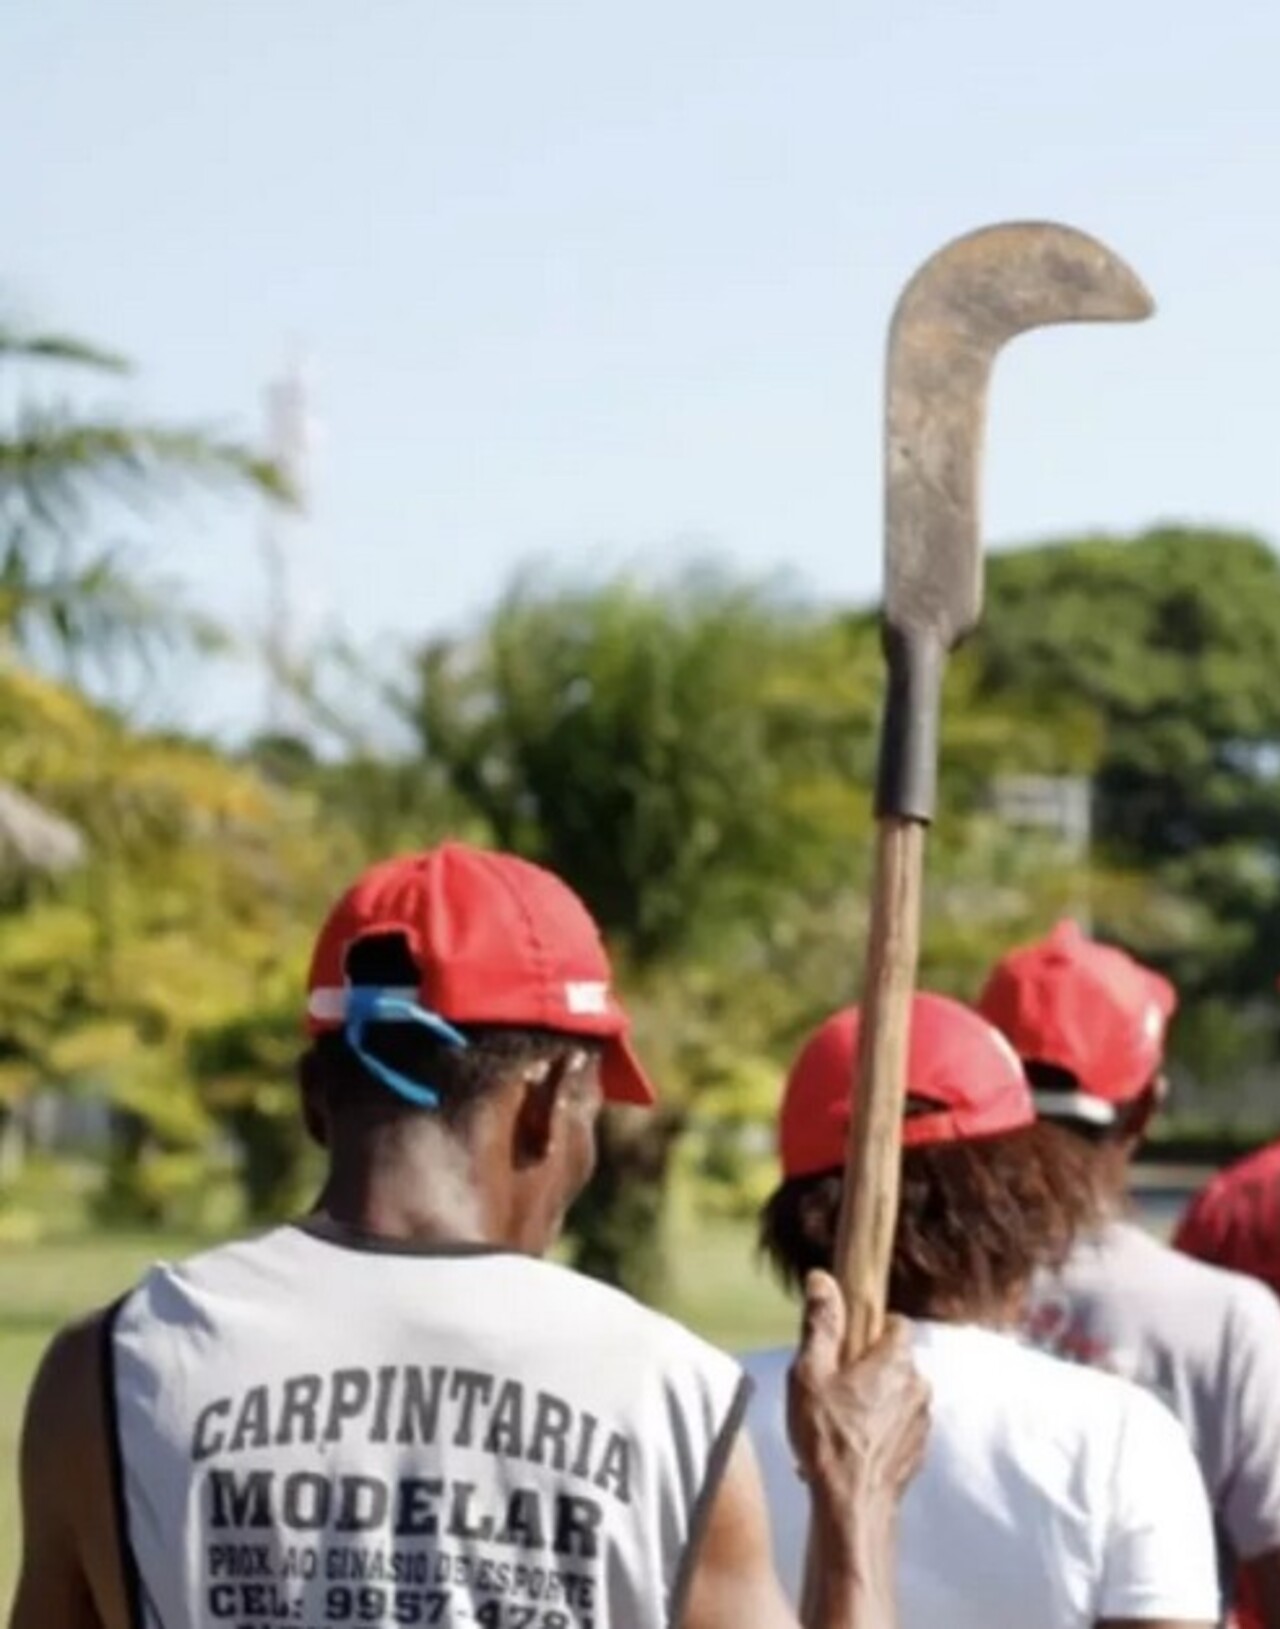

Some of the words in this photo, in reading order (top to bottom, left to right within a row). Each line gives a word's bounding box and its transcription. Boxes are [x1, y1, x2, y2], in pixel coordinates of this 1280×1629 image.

[190, 1366, 634, 1505] CARPINTARIA
[208, 1470, 603, 1558] MODELAR
[208, 1584, 304, 1619] CEL:
[282, 1545, 318, 1580] AO
[434, 1553, 474, 1586] DE
[476, 1558, 595, 1610] ESPORTE
